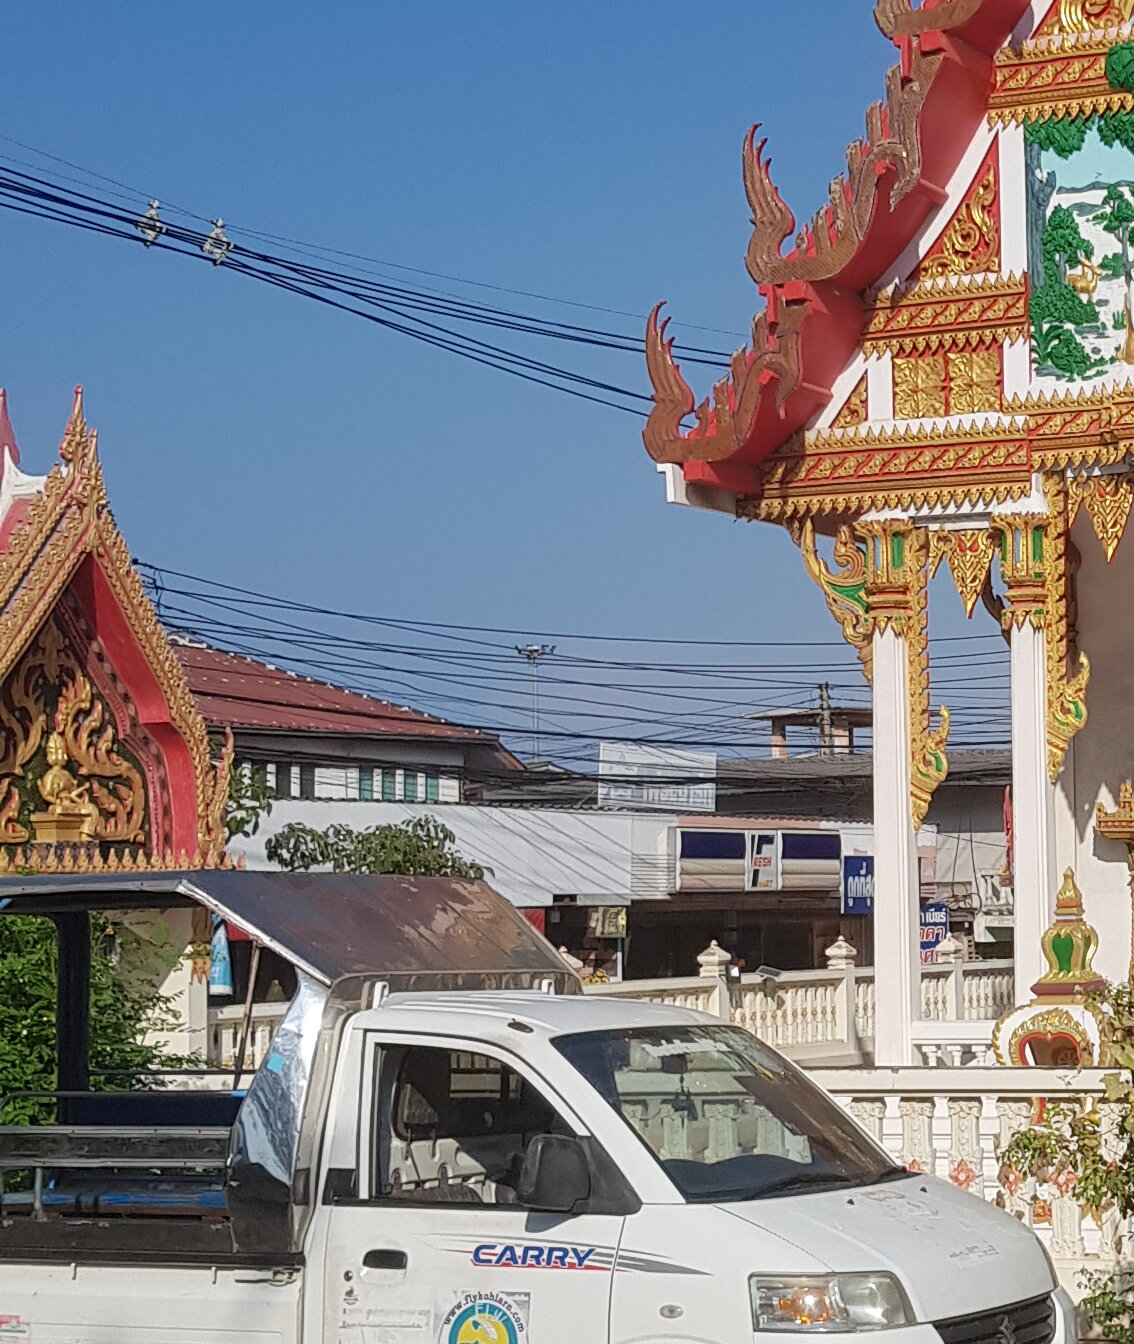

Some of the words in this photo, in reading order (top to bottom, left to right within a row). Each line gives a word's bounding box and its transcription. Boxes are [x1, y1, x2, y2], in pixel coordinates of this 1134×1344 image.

[919, 926, 945, 942] าคา
[472, 1244, 596, 1267] CARRY
[444, 1291, 525, 1333] www.flykohlarn.com
